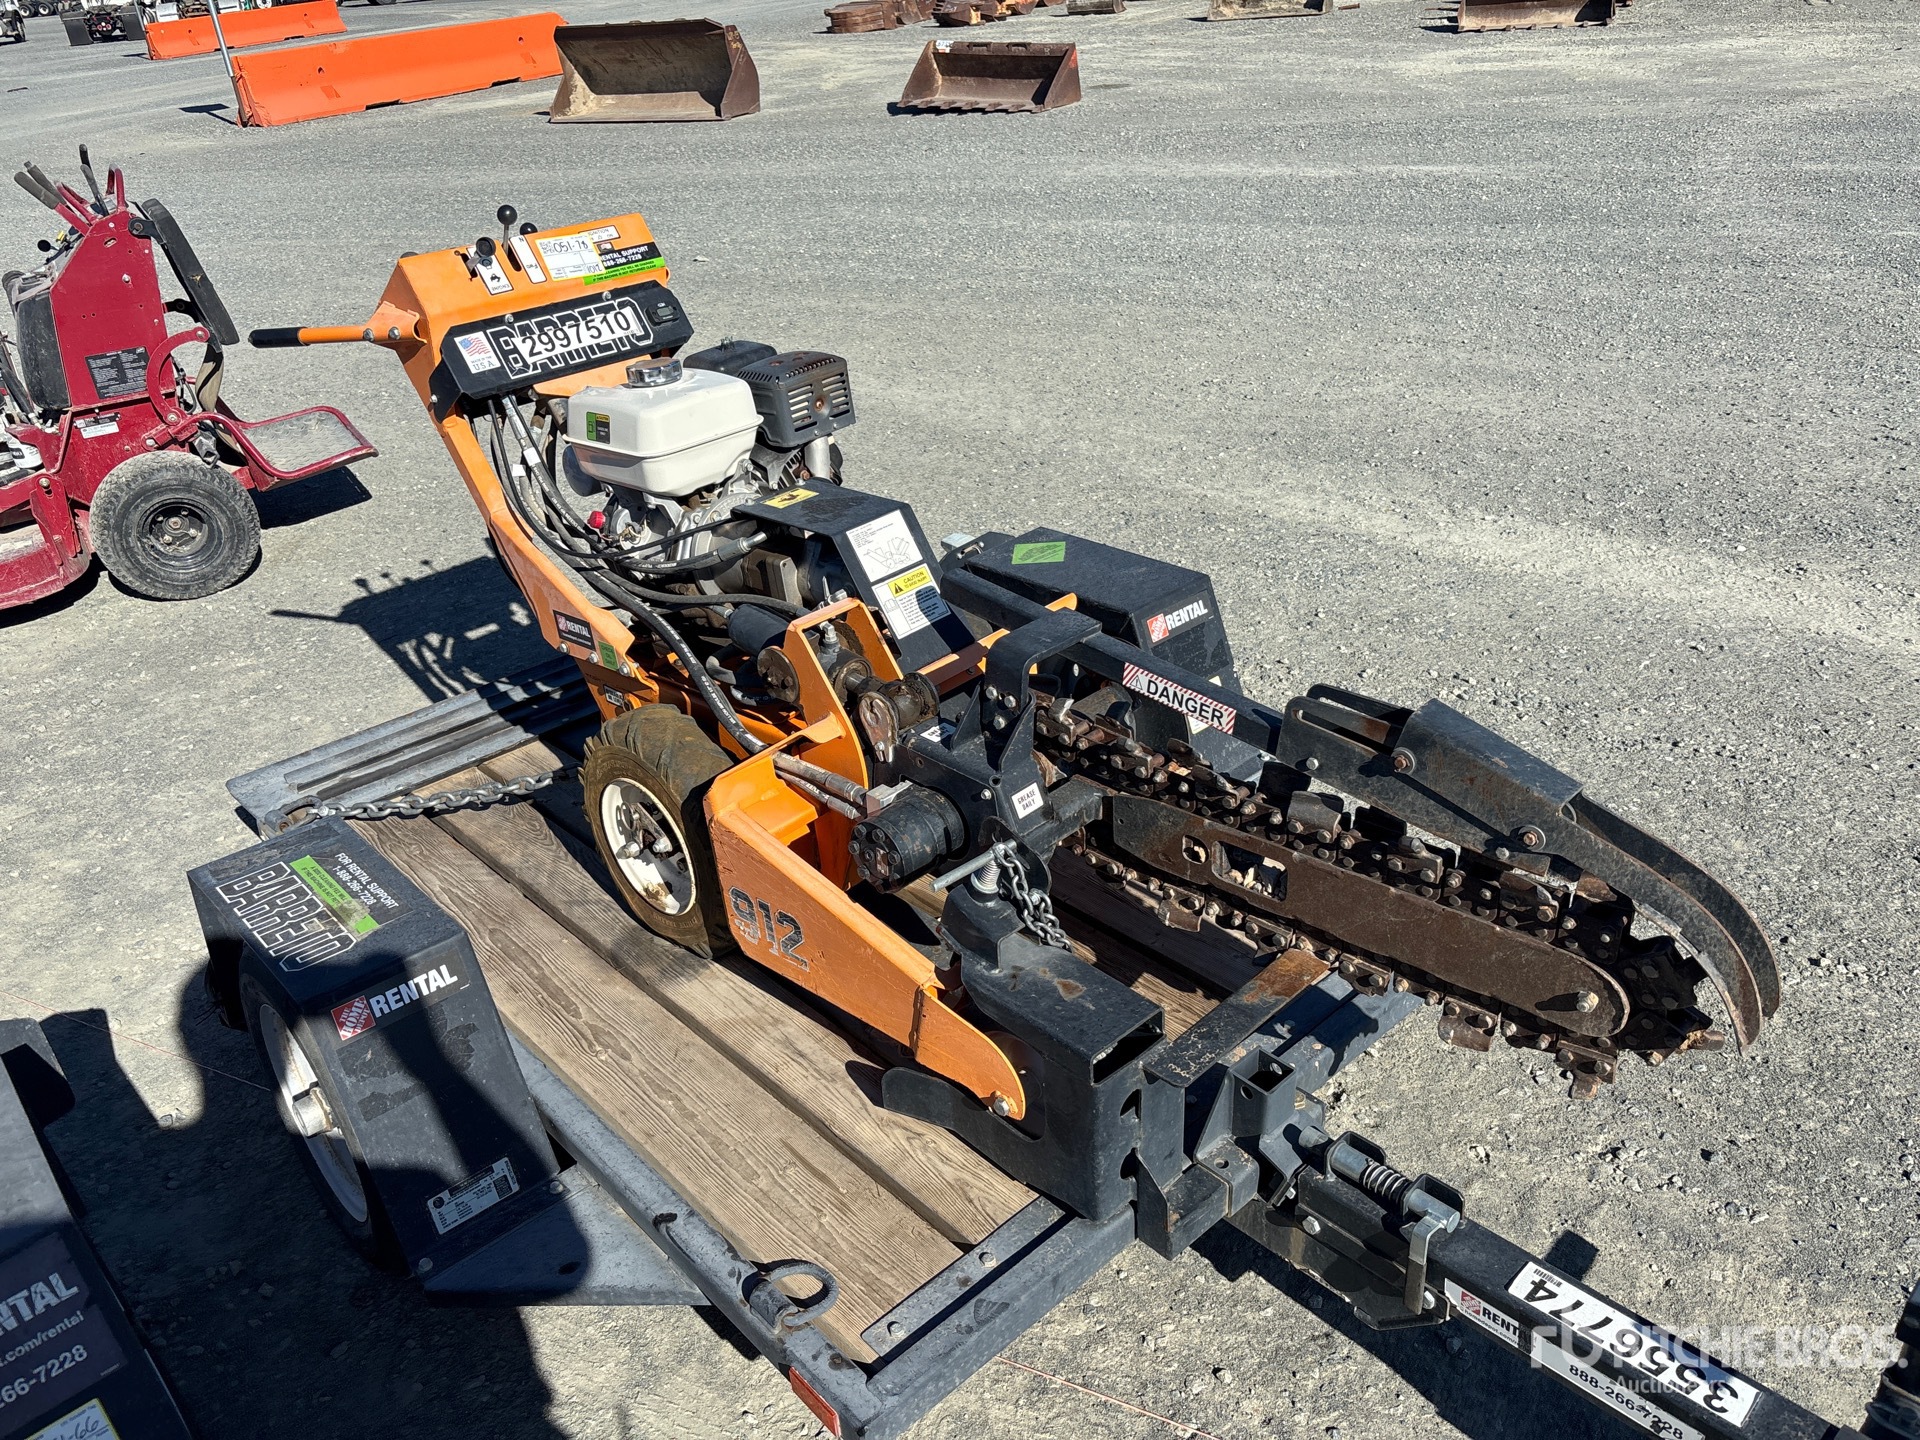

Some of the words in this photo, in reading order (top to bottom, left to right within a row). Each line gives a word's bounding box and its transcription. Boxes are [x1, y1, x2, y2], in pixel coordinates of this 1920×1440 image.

[621, 246, 649, 256] SUPPORT
[521, 310, 631, 359] 2997510
[903, 571, 924, 584] CAUTION
[566, 620, 591, 638] RENTAL
[1165, 600, 1209, 631] RENTAL
[1146, 679, 1224, 727] DANGER
[1017, 788, 1036, 805] GREASE
[1022, 799, 1036, 811] DAILY
[333, 865, 377, 906] 1-888-266-7228
[334, 852, 352, 865] FOR
[347, 862, 372, 886] RENTAL
[367, 882, 399, 910] SUPPORT
[215, 861, 357, 973] BARRETO
[728, 886, 810, 972] 912
[369, 964, 458, 1018] RENTAL
[340, 997, 368, 1039] HOME
[0, 1273, 79, 1332] NTAL
[1482, 1306, 1520, 1337] RENT
[1523, 1278, 1739, 1414] 3556774
